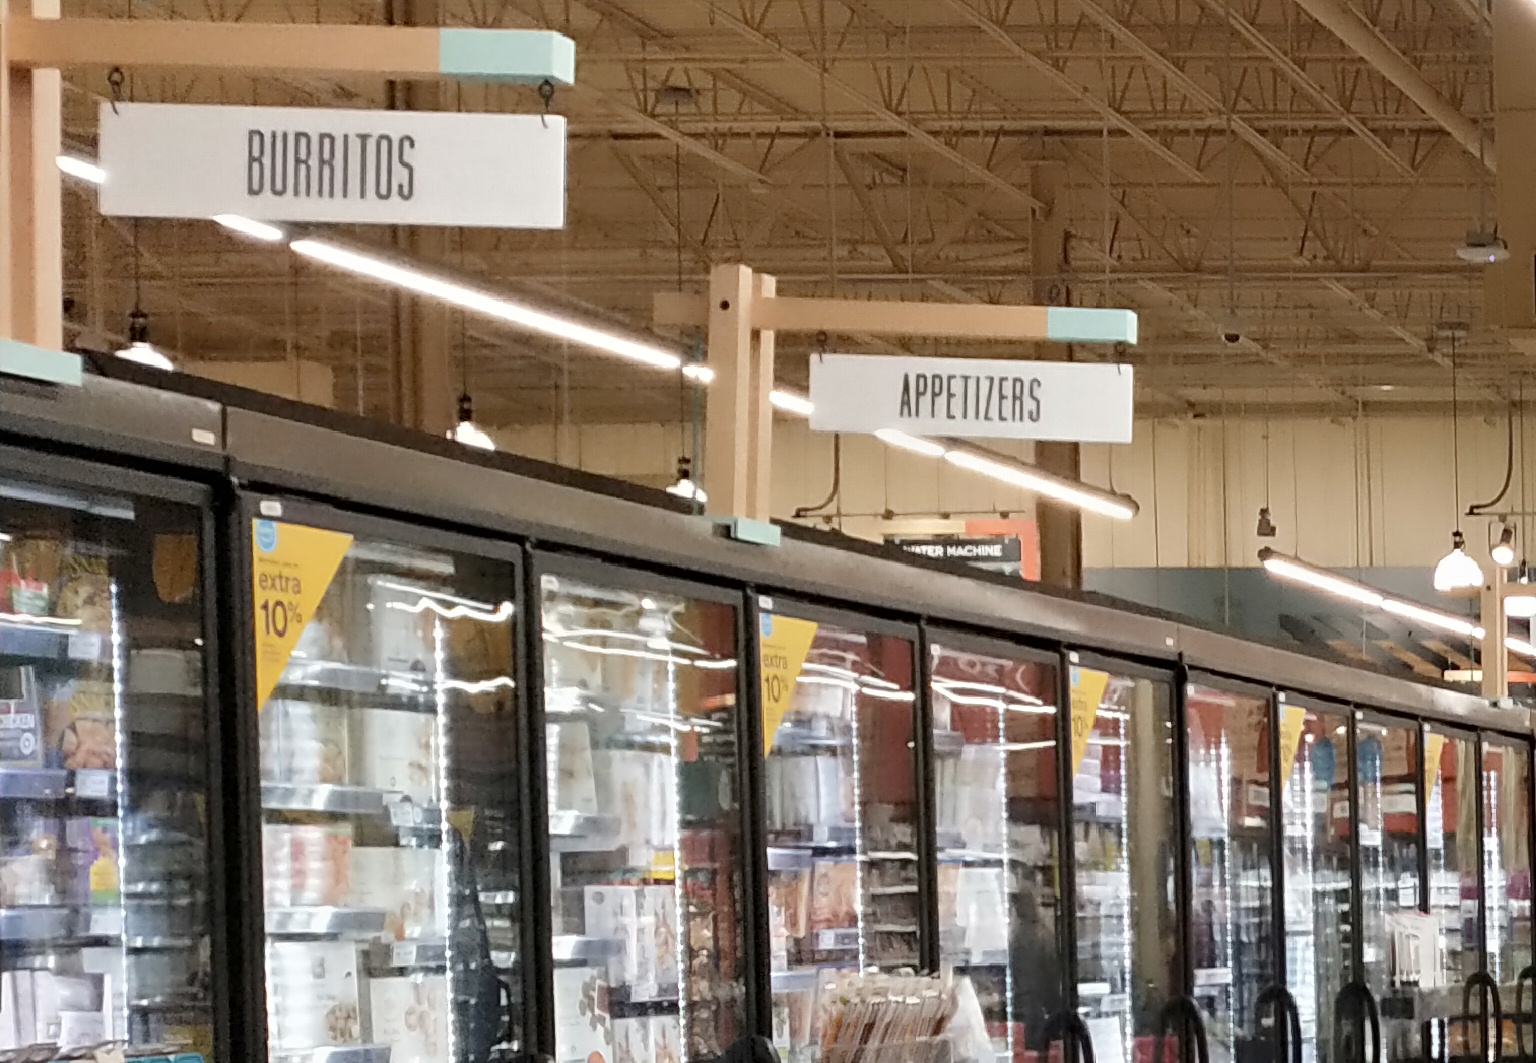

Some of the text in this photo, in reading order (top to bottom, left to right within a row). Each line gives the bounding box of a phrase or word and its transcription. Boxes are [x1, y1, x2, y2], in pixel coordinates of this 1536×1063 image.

[247, 129, 415, 201] BURRITOS
[899, 371, 1042, 423] APPETIZERS
[947, 545, 1002, 557] MACHINE
[258, 571, 302, 595] extra
[260, 599, 303, 638] 10%
[763, 653, 788, 670] extra
[764, 673, 789, 704] 10%
